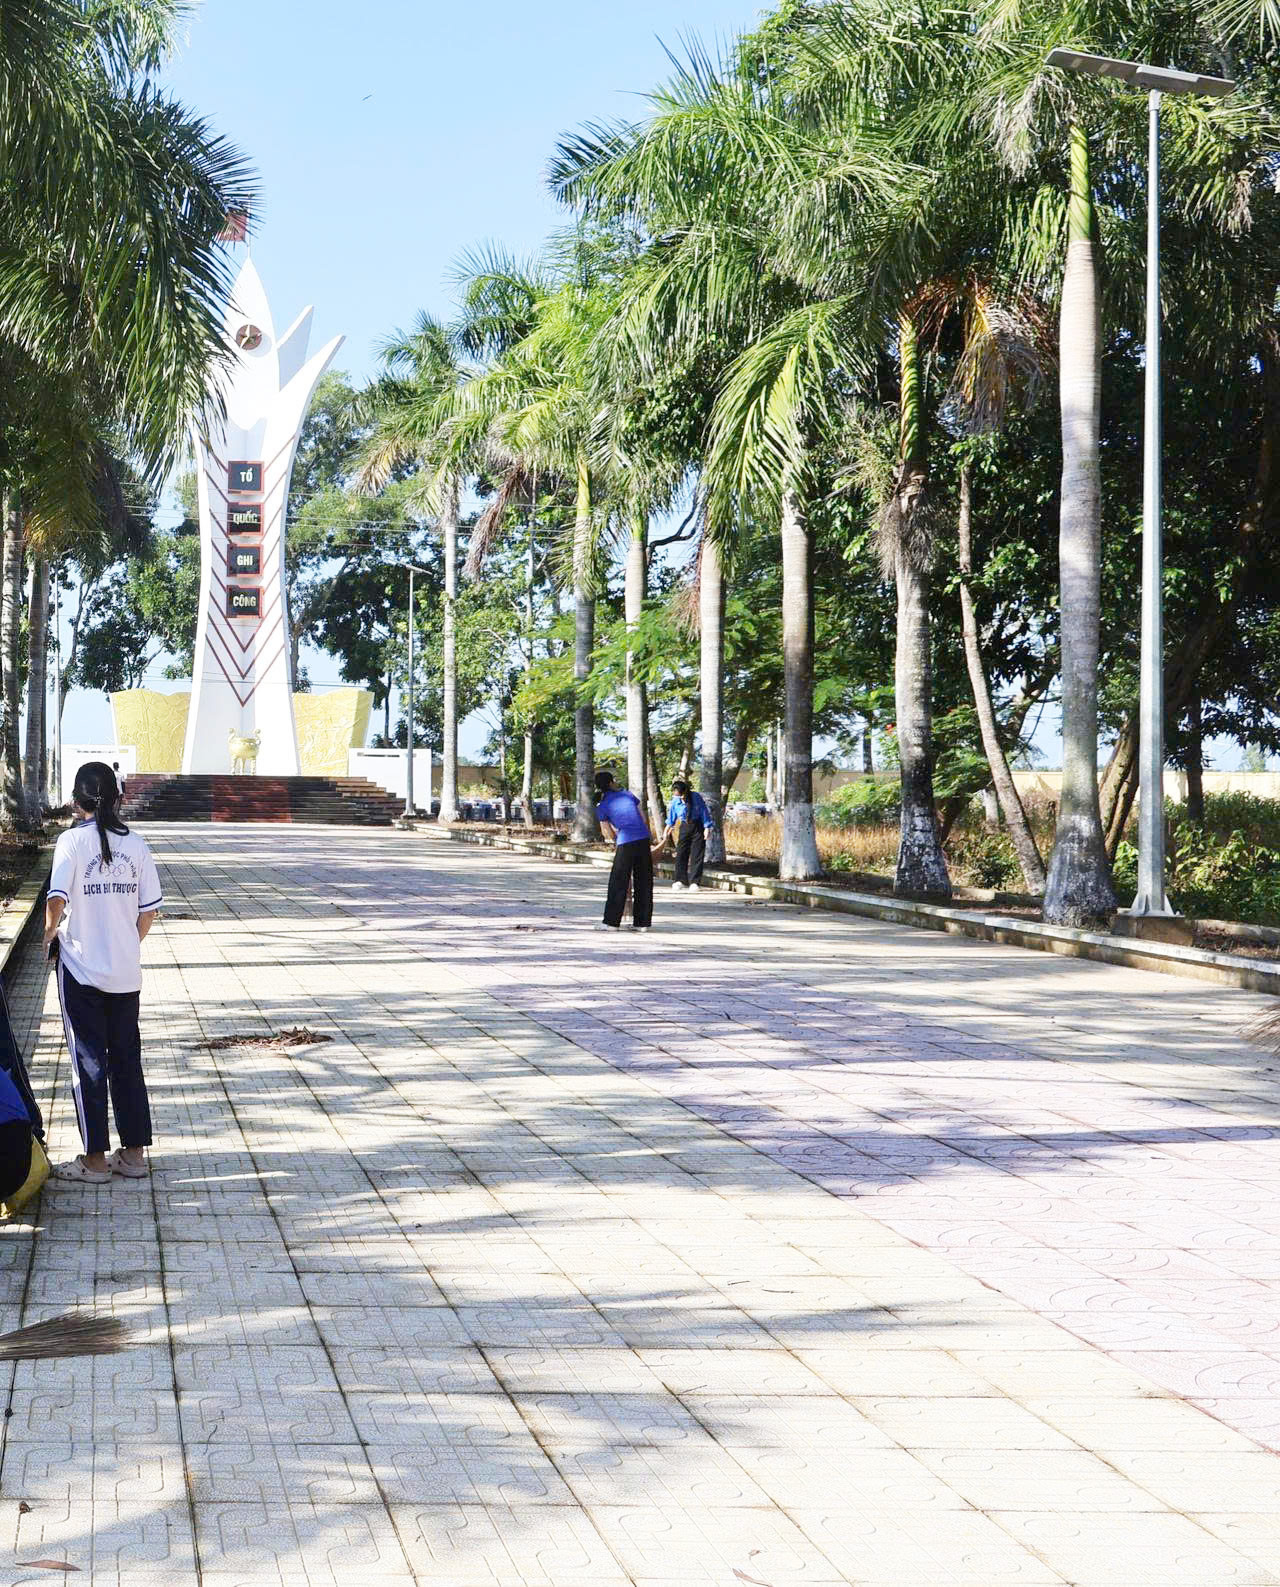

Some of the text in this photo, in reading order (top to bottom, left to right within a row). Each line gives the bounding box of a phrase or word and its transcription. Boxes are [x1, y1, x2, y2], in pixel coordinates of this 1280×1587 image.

[236, 554, 254, 566] GHI
[232, 593, 257, 607] CÔNG
[83, 883, 102, 897] LỊCH
